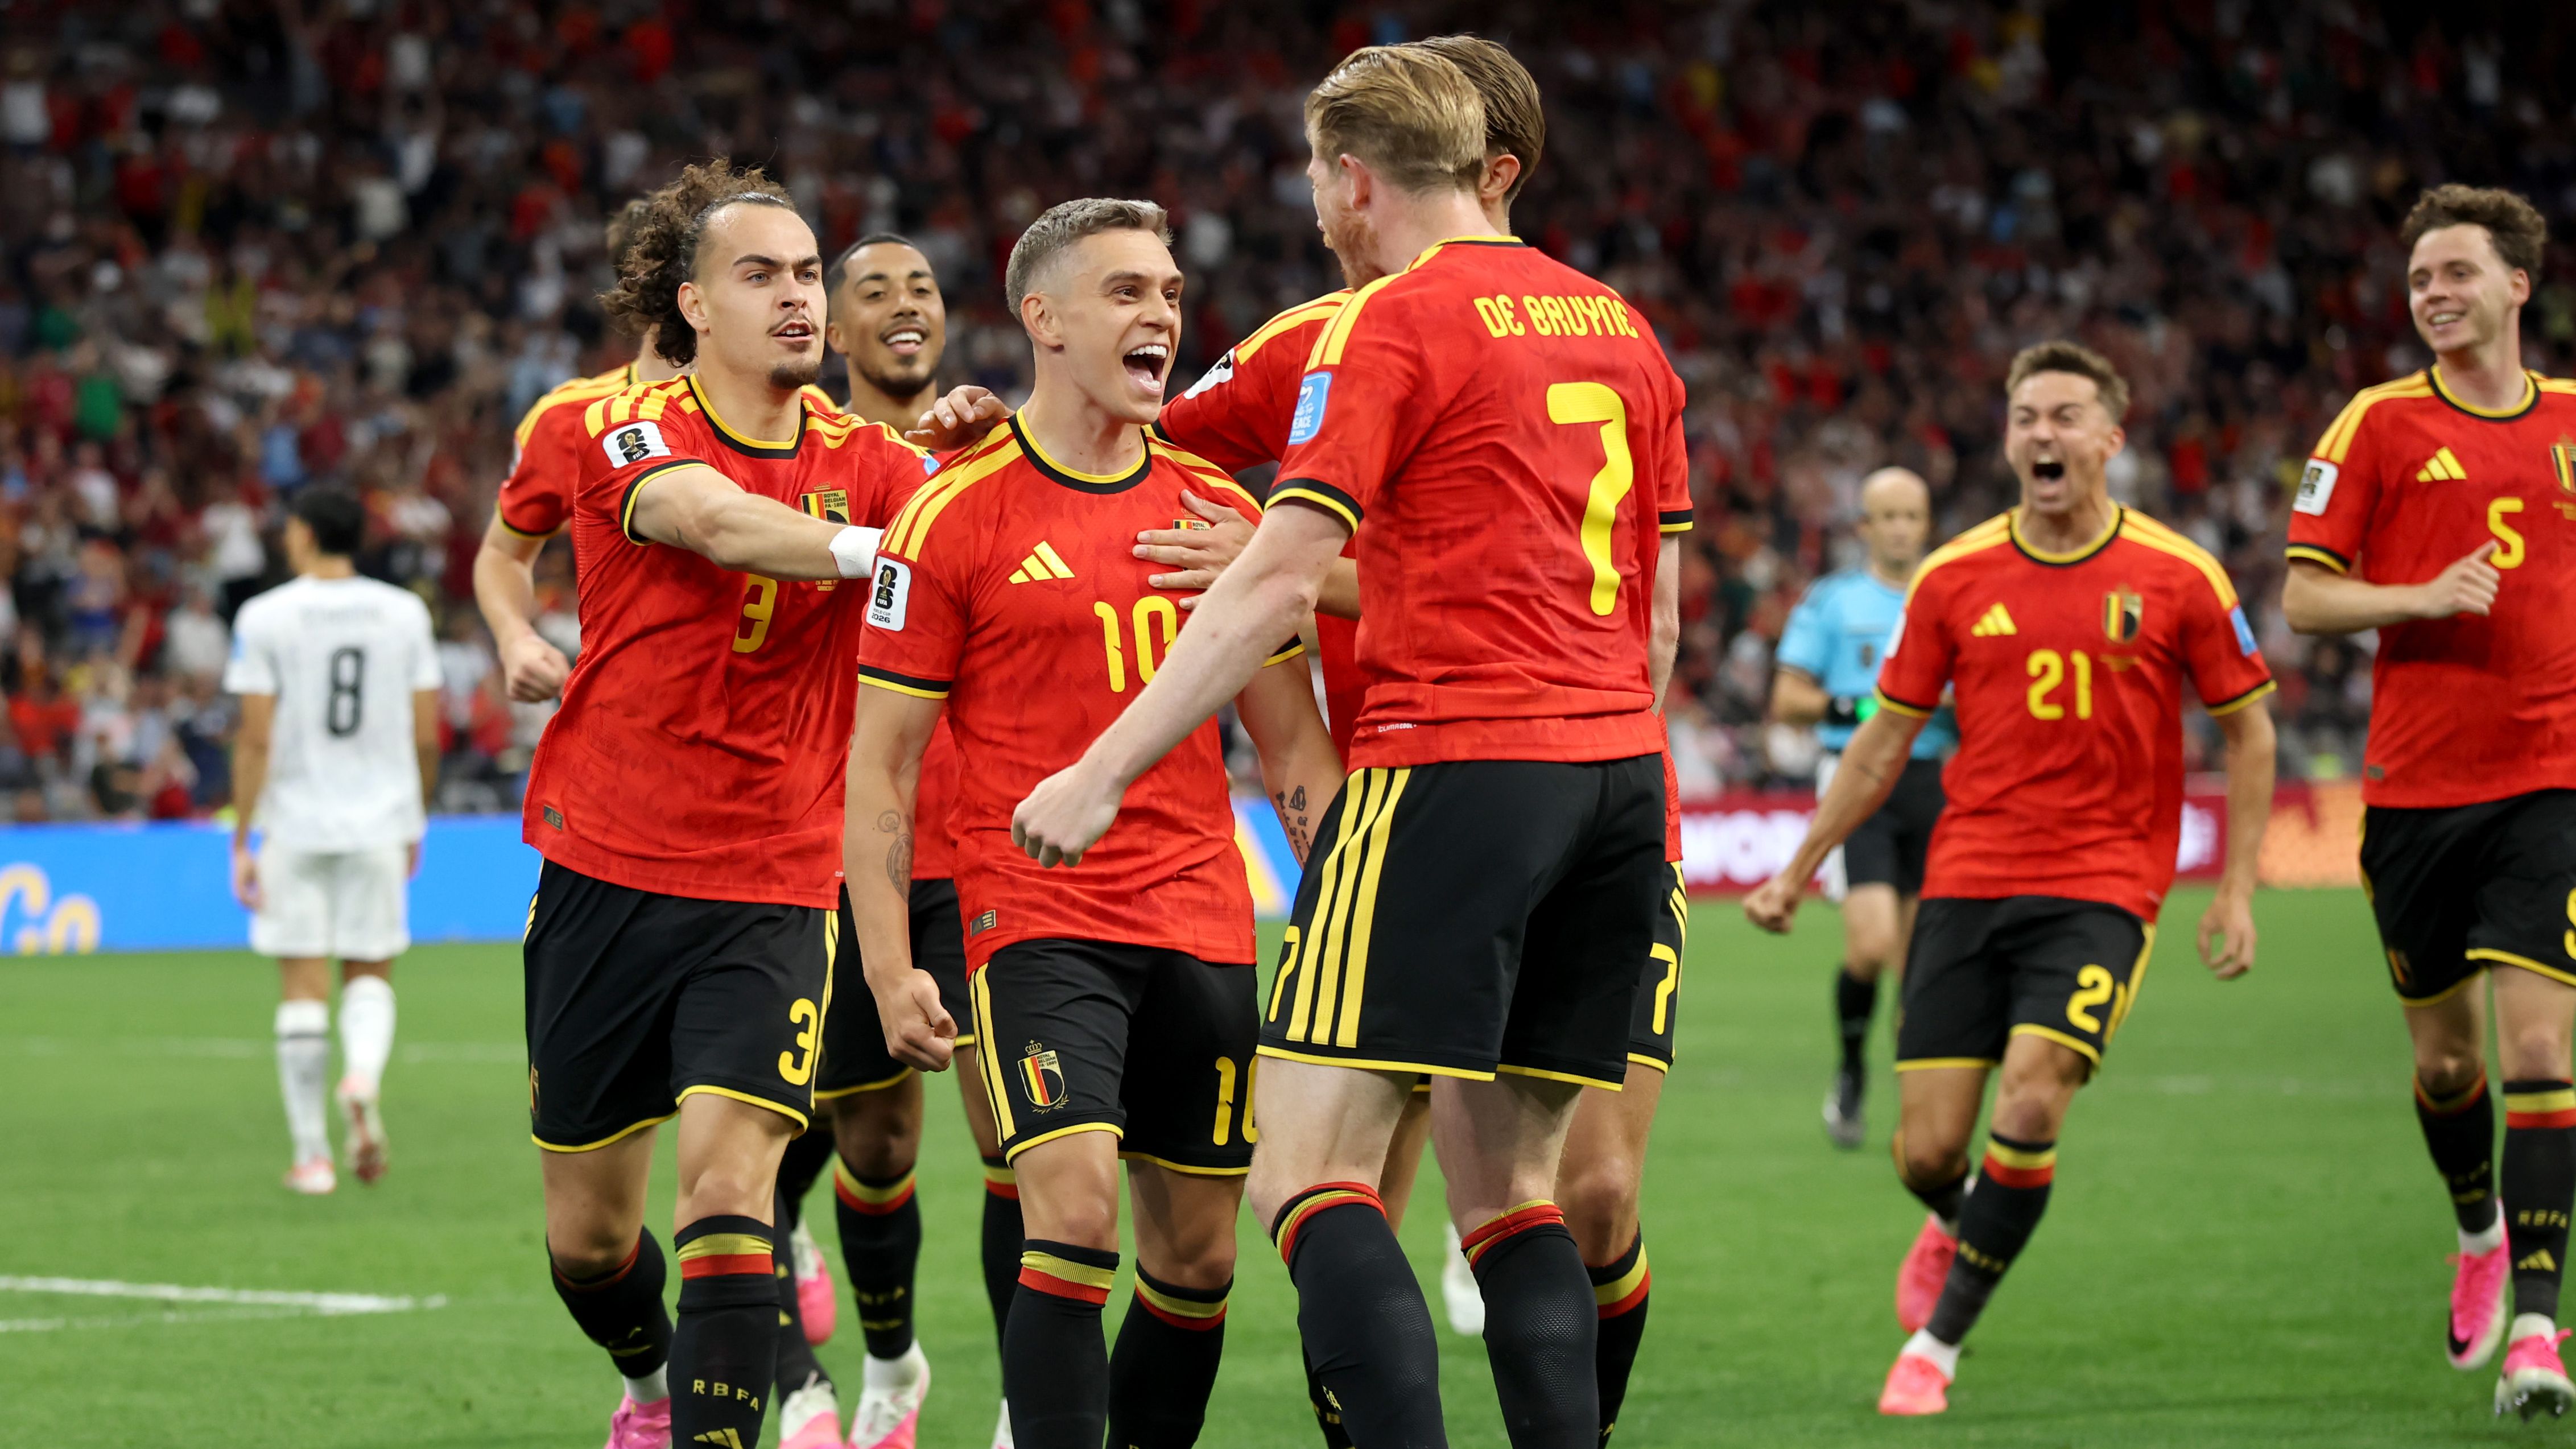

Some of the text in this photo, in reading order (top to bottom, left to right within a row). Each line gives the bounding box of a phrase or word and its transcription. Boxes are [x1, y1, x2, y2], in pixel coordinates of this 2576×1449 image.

[1473, 294, 1638, 338] DE BRUYNE
[1546, 381, 1634, 616] 7
[2487, 496, 2525, 569] 5
[732, 573, 778, 653] 3
[872, 613, 891, 624] 2026
[877, 598, 887, 606] FIFA
[1093, 595, 1177, 693] 10
[2026, 648, 2093, 720] 21
[327, 644, 365, 738] 8
[1269, 925, 1301, 1022] 7
[1649, 942, 1678, 1035] 7
[778, 998, 818, 1086] 3
[693, 1379, 759, 1412] RBFA
